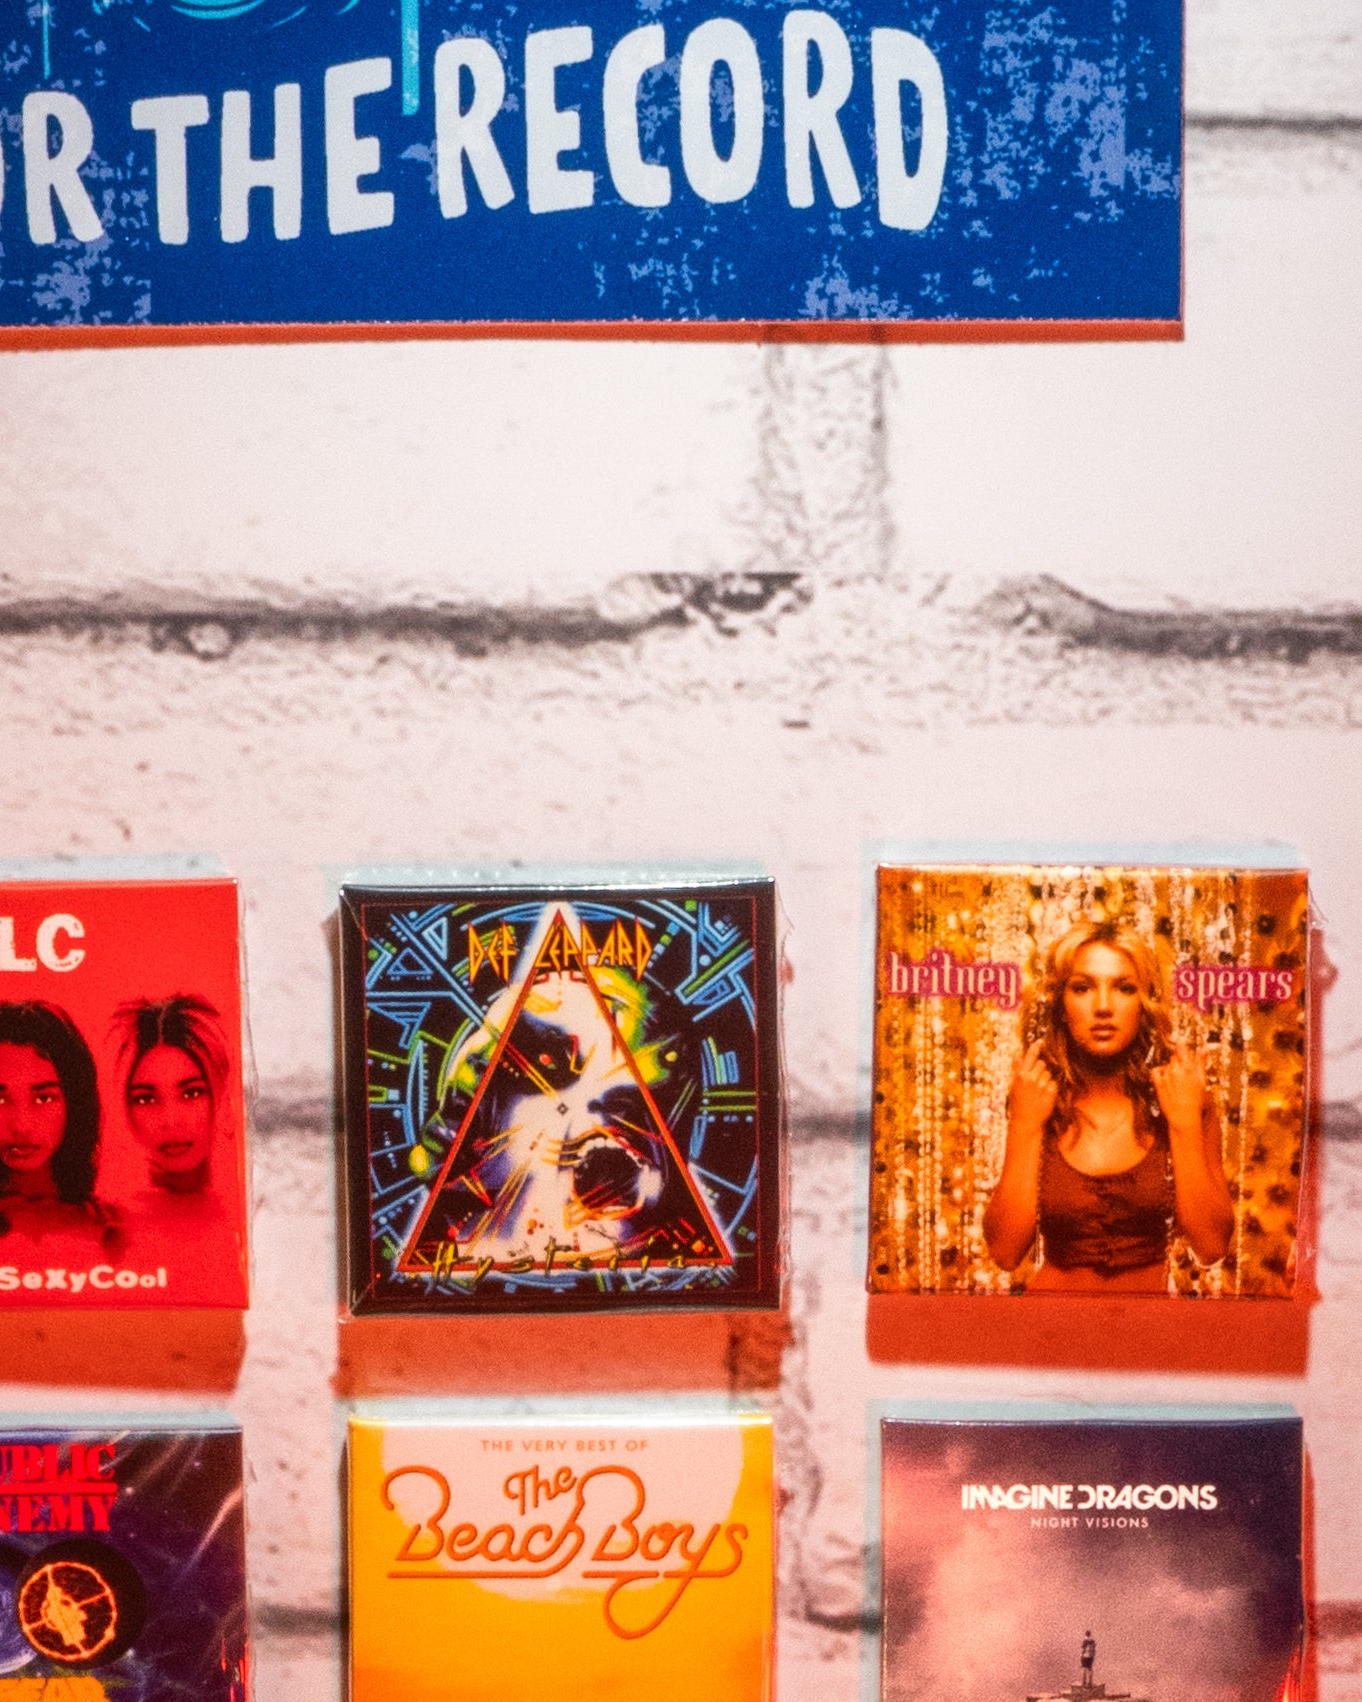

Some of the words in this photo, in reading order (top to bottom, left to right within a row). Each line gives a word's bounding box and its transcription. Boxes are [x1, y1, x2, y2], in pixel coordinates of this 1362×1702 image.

[129, 57, 395, 246] THE
[432, 9, 949, 233] RECORD
[467, 920, 517, 986] DEF
[534, 915, 654, 983] LEPPARD
[889, 946, 1019, 1008] britney
[1177, 968, 1294, 1012] spears
[480, 1439, 514, 1453] THE
[521, 1439, 569, 1453] VERY
[576, 1439, 618, 1453] BEST
[624, 1438, 650, 1453] OF
[503, 1465, 578, 1516] The
[961, 1484, 1075, 1511] IMAGINE
[1077, 1484, 1219, 1511] DRAGONS
[381, 1464, 586, 1579] Beach
[579, 1464, 749, 1640] Boys
[1030, 1516, 1079, 1530] NIGHT
[1085, 1516, 1151, 1530] VISIONS
